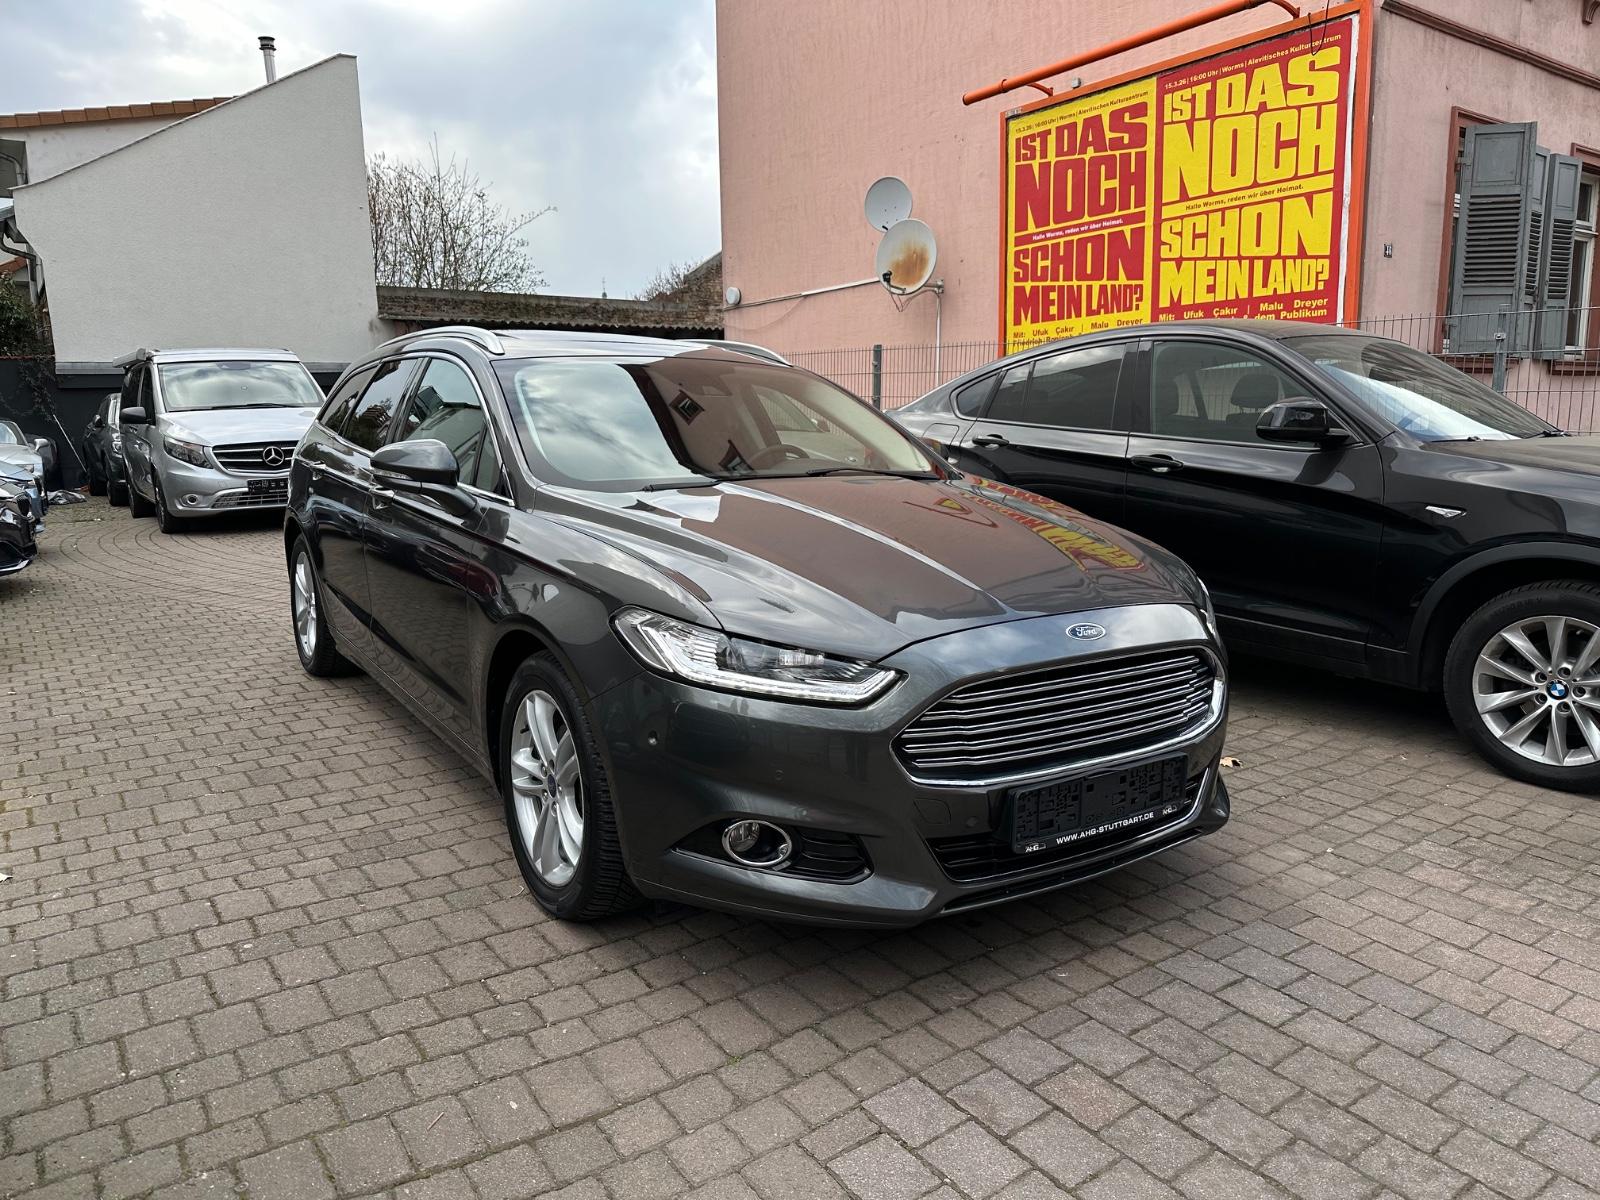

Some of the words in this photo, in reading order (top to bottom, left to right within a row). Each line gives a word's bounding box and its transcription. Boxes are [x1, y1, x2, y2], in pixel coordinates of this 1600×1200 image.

[1164, 79, 1187, 90] 15.3.26
[1190, 73, 1207, 83] 16:00
[1207, 69, 1219, 78] Uhr
[1222, 62, 1245, 73] Worms
[1247, 49, 1289, 66] Alevitisches
[1164, 81, 1211, 123] IST
[1215, 46, 1341, 117] DAS
[1059, 112, 1076, 121] Worms
[1110, 91, 1149, 106] Kulturzentrum
[1015, 128, 1052, 163] IST
[1055, 101, 1148, 157] DAS
[1162, 103, 1338, 204] NOCH
[1014, 151, 1147, 233] NOCH
[1185, 202, 1202, 211] Hallo
[1203, 198, 1227, 208] Worms,
[1227, 195, 1246, 203] reden
[1260, 188, 1275, 197] über
[1276, 183, 1304, 195] Heimat.
[1032, 233, 1046, 241] Hallo
[1065, 226, 1080, 235] reden
[1080, 224, 1089, 232] wir
[1089, 221, 1101, 230] über
[1102, 218, 1124, 228] Heimat.
[1161, 191, 1333, 258] SCHON
[1013, 226, 1144, 283] SCHON
[1159, 259, 1249, 308] MEIN
[1253, 259, 1330, 298] LAND?
[1013, 284, 1082, 326] MEIN
[1086, 284, 1144, 318] LAND?
[1159, 313, 1175, 322] Mit:
[1183, 310, 1204, 319] Ufuk
[1213, 307, 1238, 318] Çakır
[1260, 302, 1284, 312] Malu
[1293, 298, 1329, 309] Dreyer
[1254, 312, 1275, 320] dem
[1280, 308, 1327, 320] Publikum
[1032, 329, 1049, 337] Ufuk
[1090, 321, 1109, 330] Malu
[1117, 318, 1143, 327] Dreyer
[1075, 626, 1097, 637] Ford
[1056, 811, 1154, 845] WWW.AHG-STUTTGART.DE
